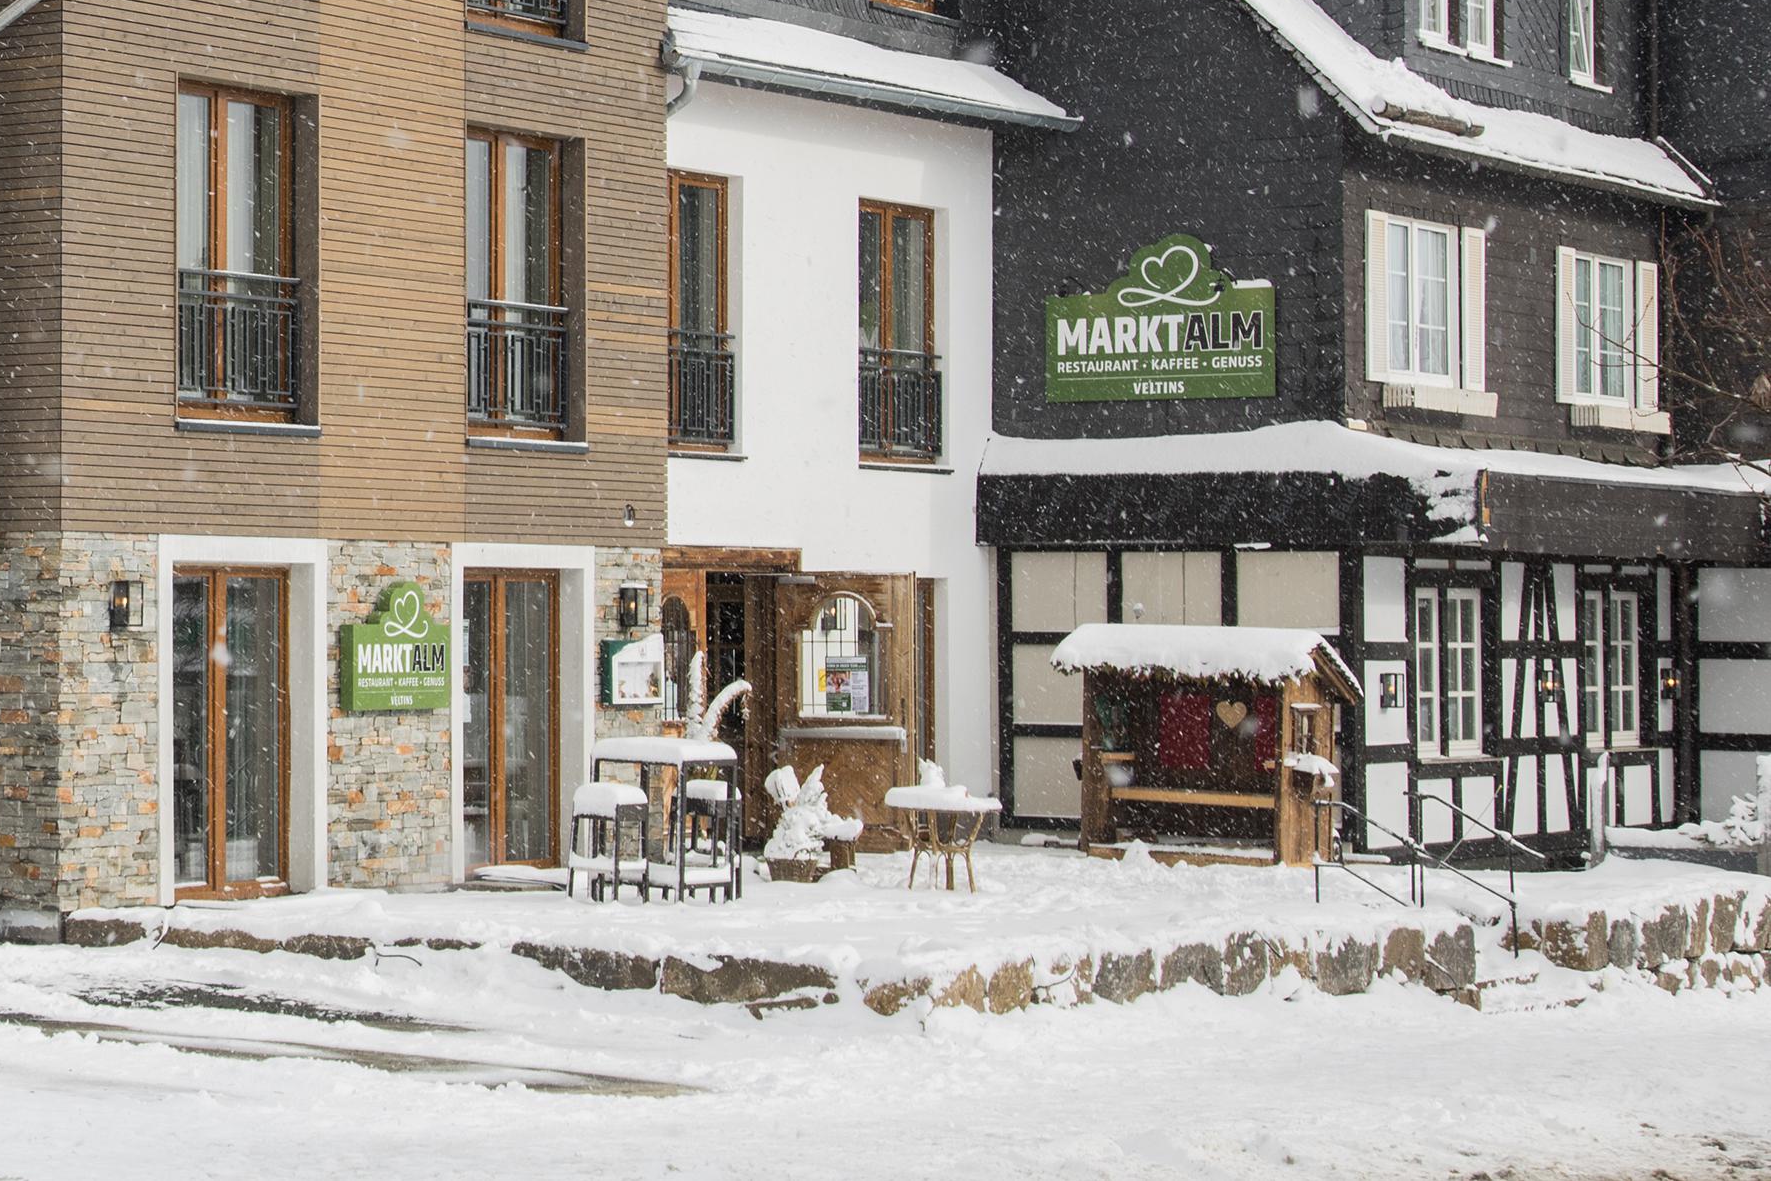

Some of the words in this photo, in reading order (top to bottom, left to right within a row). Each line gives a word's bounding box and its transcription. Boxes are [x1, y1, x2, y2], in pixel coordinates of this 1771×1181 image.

[1057, 310, 1264, 355] MARKTALM
[1057, 359, 1139, 374] RESTAURANT
[1151, 357, 1199, 370] KAFFEE
[1211, 355, 1263, 368] GENUSS
[1133, 381, 1185, 395] VELTINS
[357, 643, 446, 674] MARKTALM
[357, 678, 394, 688] RESTAURANT
[398, 677, 419, 686] KAFFEE
[423, 677, 445, 687] GENUSS
[390, 695, 413, 706] VELTINS
